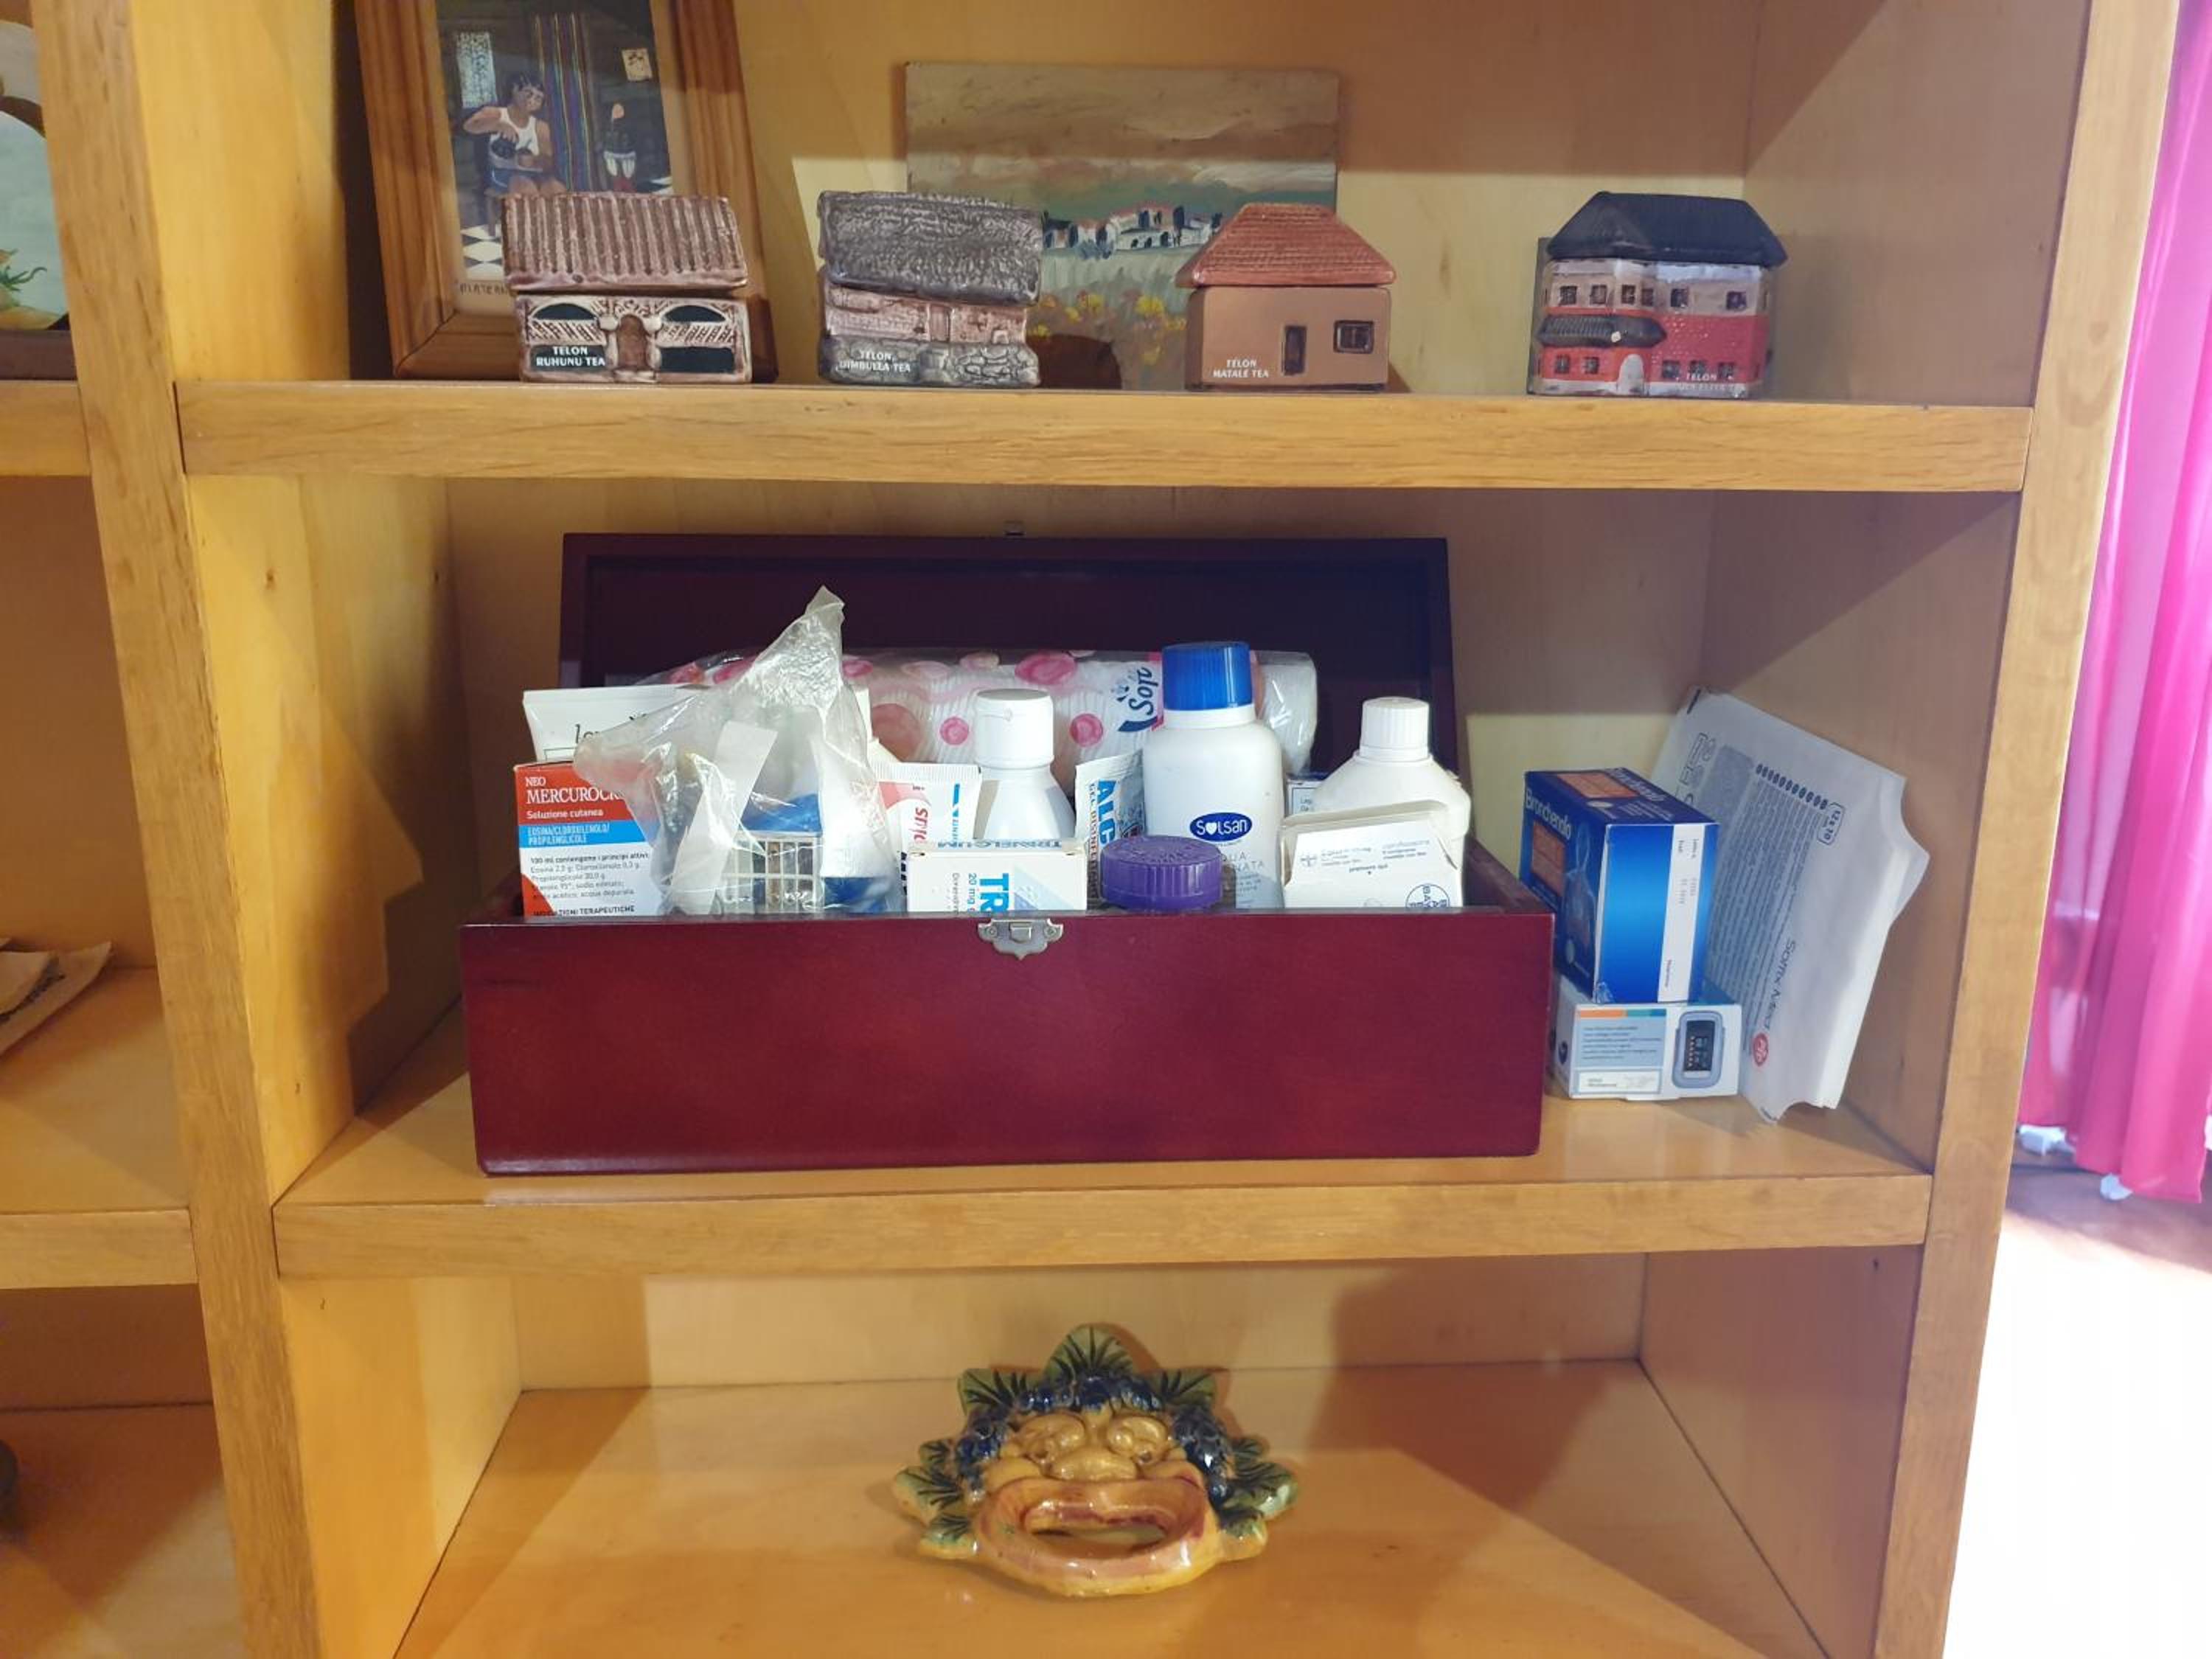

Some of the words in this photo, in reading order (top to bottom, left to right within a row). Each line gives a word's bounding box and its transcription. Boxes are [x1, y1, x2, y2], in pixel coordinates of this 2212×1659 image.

[553, 346, 588, 355] TELON
[859, 350, 892, 360] TELON
[536, 357, 582, 366] RUHUNU
[585, 357, 605, 366] TEA
[1226, 359, 1256, 368] TELON
[893, 363, 911, 372] TEA
[1213, 369, 1251, 378] MATALE
[1252, 369, 1269, 378] TEA
[525, 776, 546, 787] NEO
[526, 810, 568, 819] Soluzione
[570, 809, 604, 818] cutanea
[967, 888, 976, 905] mg
[580, 905, 636, 914] TERAPEUTICHE
